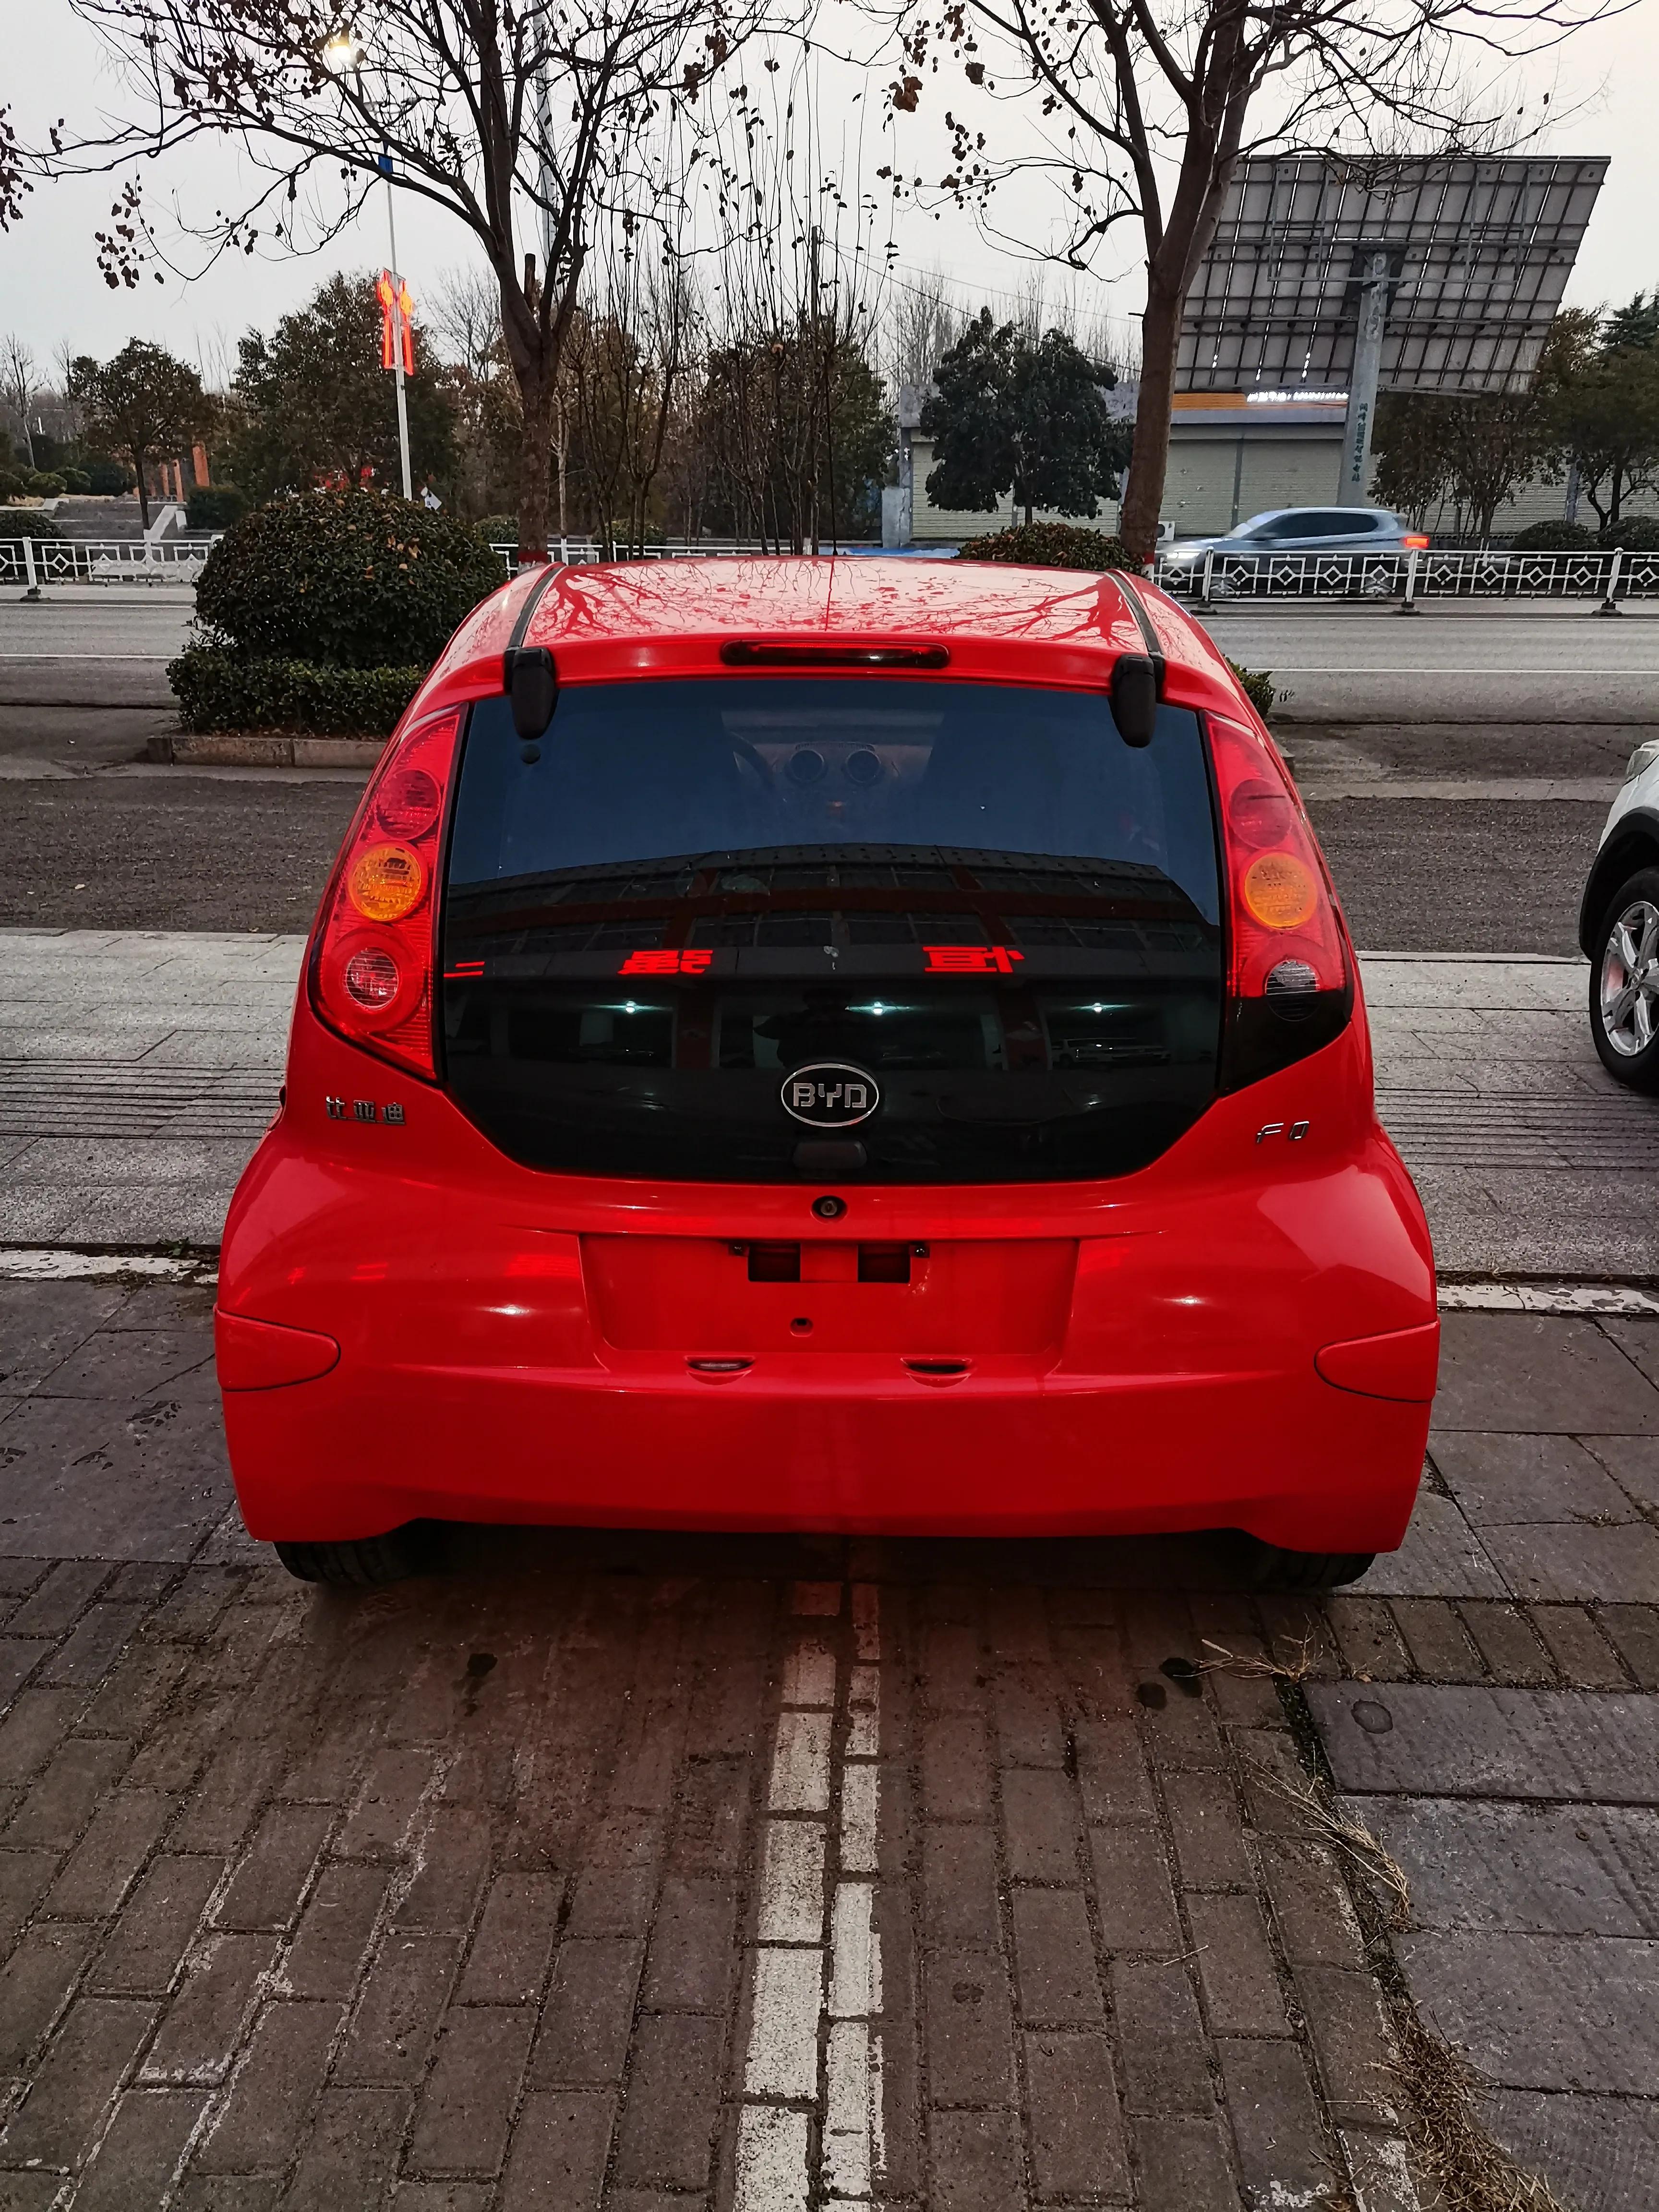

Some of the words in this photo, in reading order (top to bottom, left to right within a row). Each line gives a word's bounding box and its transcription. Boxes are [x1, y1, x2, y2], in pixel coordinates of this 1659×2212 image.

[793, 1083, 867, 1108] BYD
[326, 1096, 405, 1125] 比亚迪
